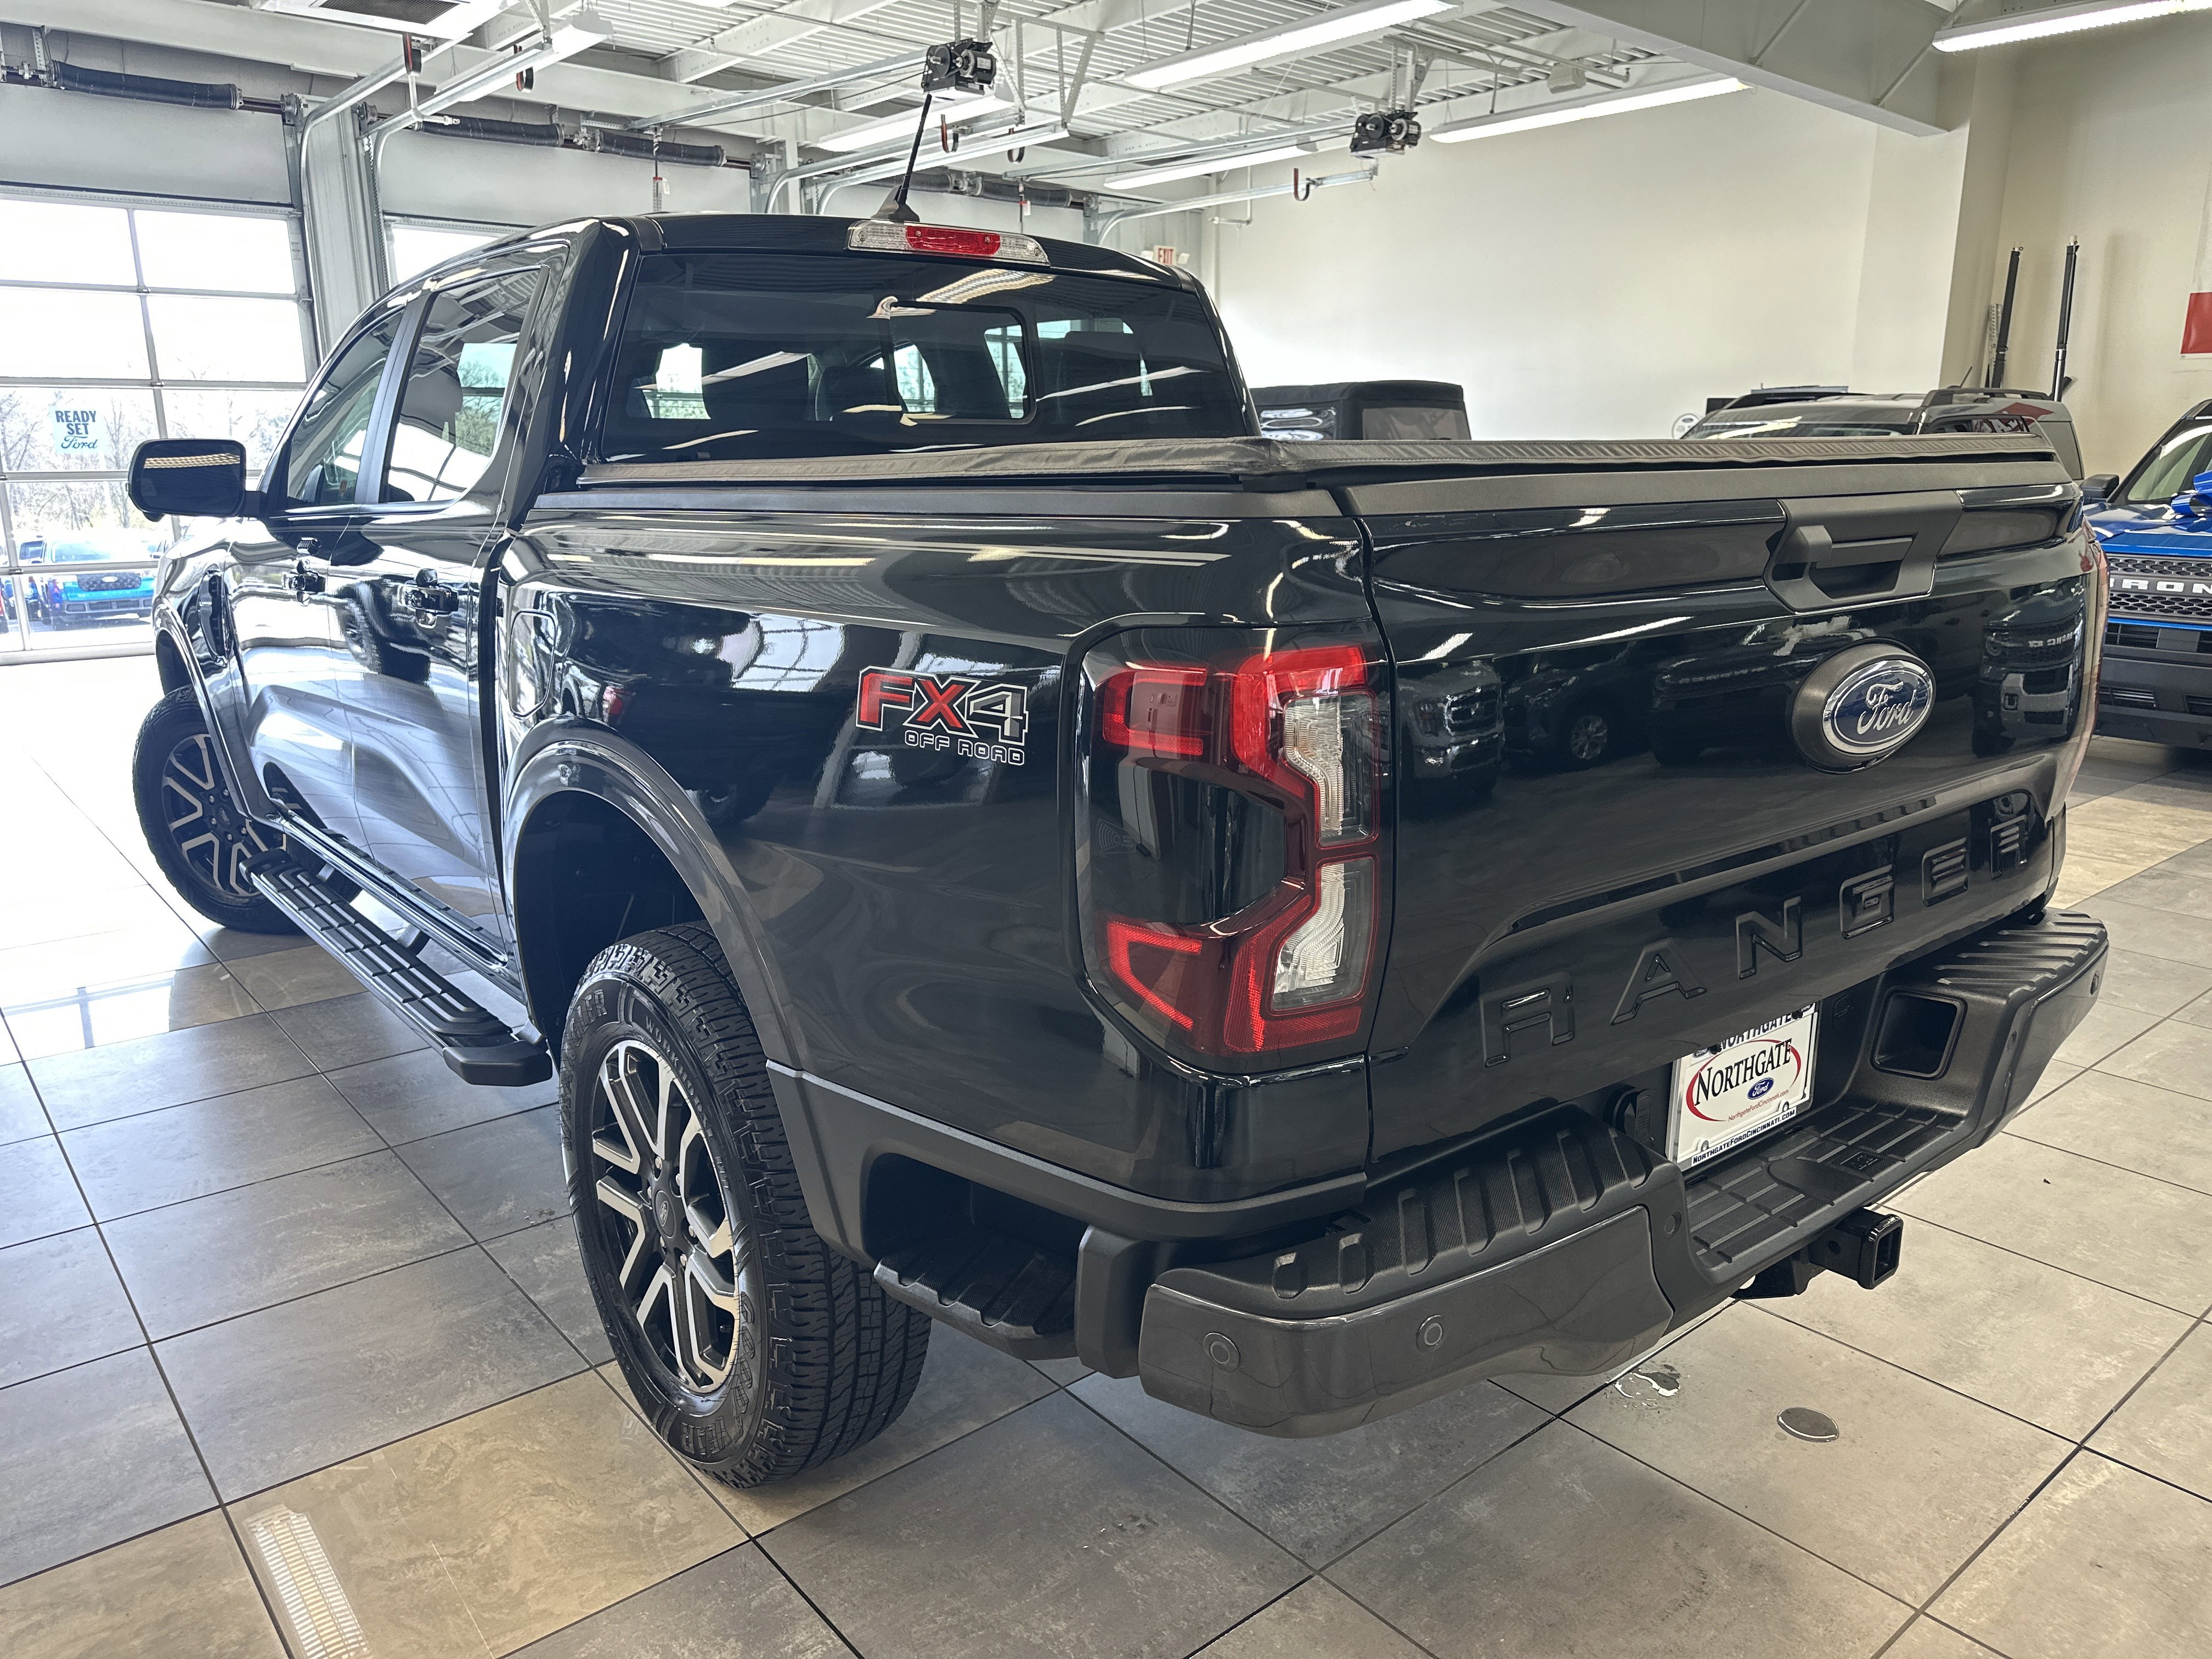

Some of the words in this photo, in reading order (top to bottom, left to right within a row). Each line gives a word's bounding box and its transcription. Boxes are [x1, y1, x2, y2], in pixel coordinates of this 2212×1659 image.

[1158, 247, 1173, 264] EXIT
[55, 410, 96, 422] READY
[66, 423, 88, 435] SET
[61, 435, 98, 449] Ford
[855, 665, 1029, 746] FX4
[1857, 680, 1917, 735] Ford
[905, 730, 950, 751] OFF
[957, 738, 1025, 766] ROAD
[1480, 814, 2028, 1068] RANGER
[1752, 1081, 1770, 1097] Ford
[1728, 1089, 1790, 1122] NorthgateFordCincinnati.com
